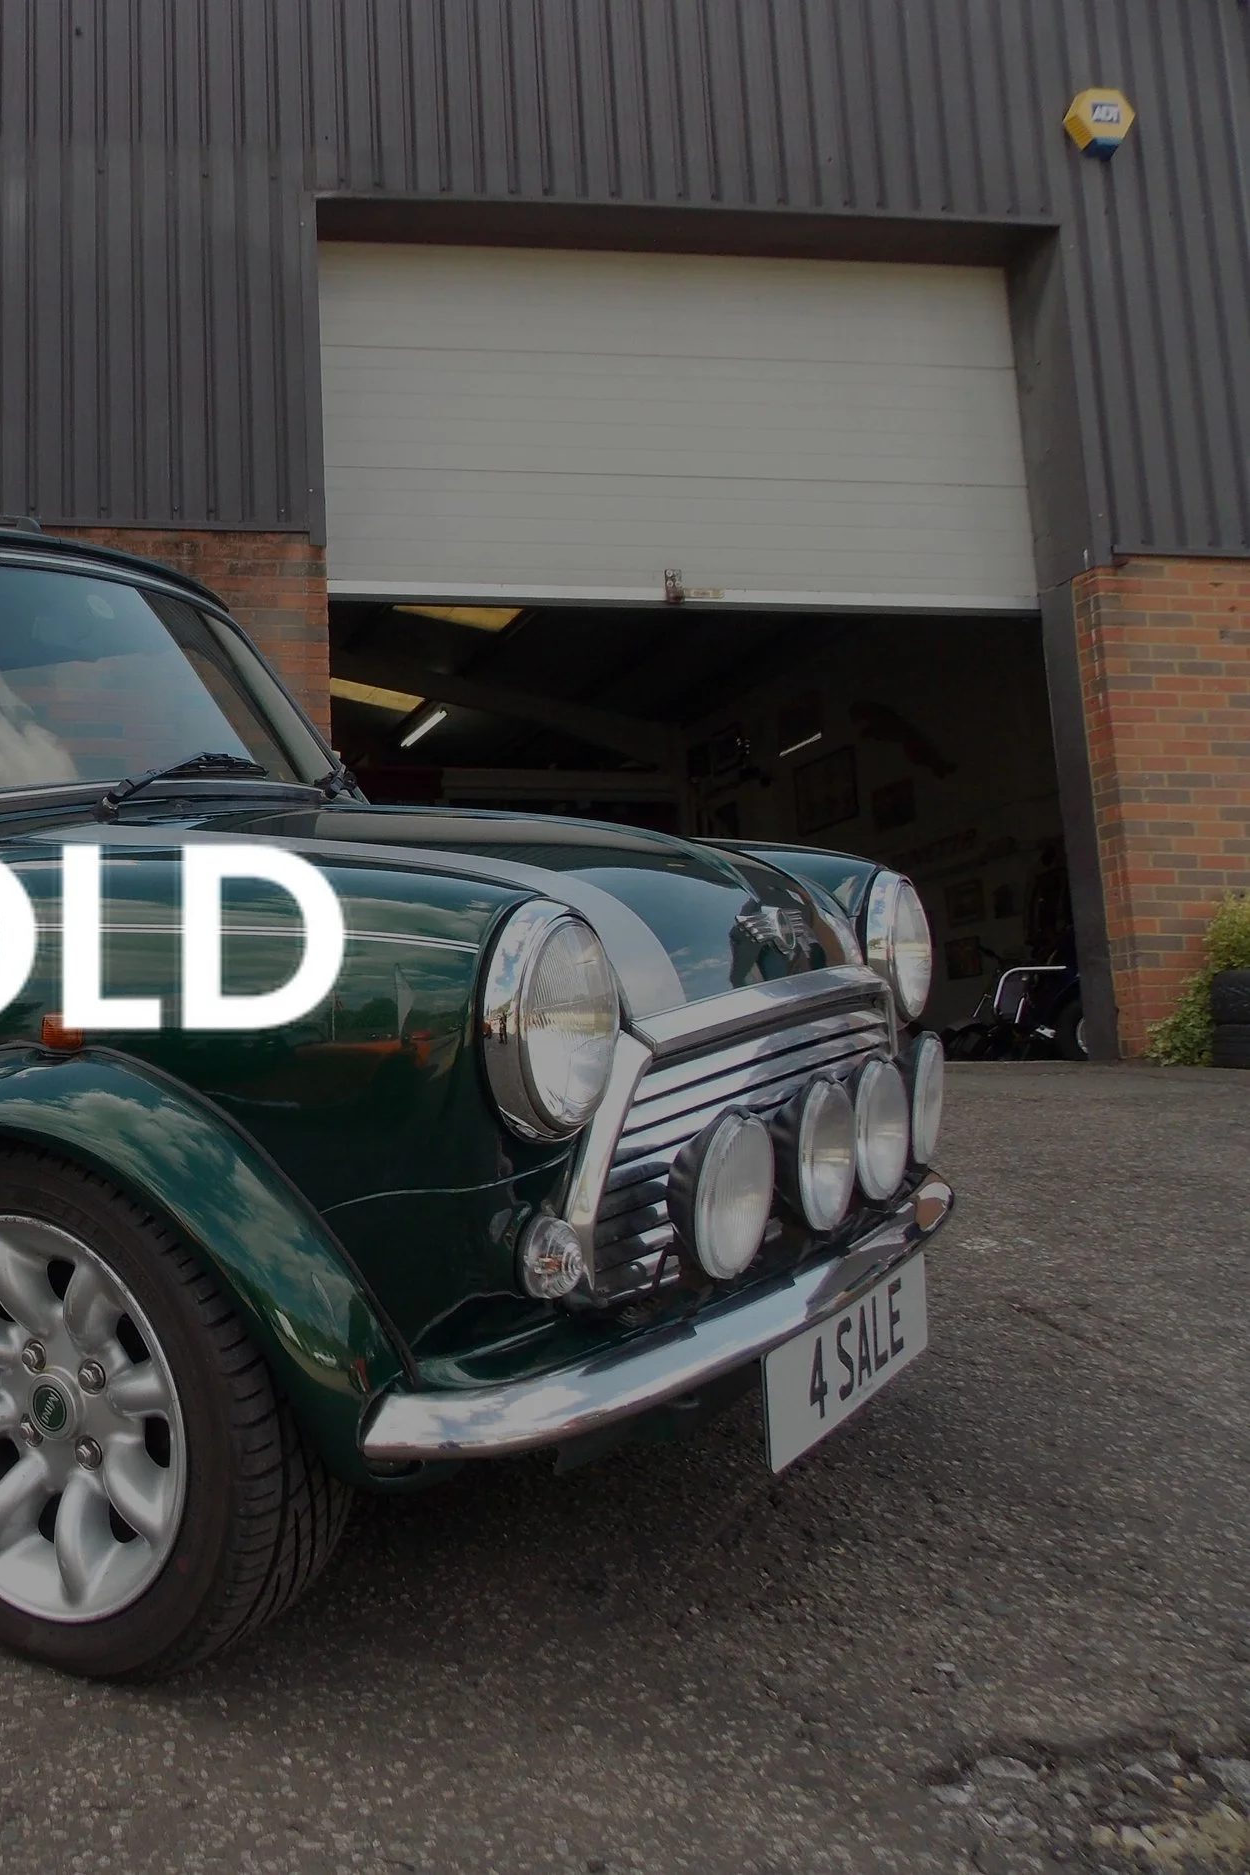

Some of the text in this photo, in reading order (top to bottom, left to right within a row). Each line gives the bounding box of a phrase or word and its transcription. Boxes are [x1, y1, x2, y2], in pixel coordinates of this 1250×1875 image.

[810, 1276, 904, 1419] 4 SALE
[41, 1391, 59, 1424] MINI
